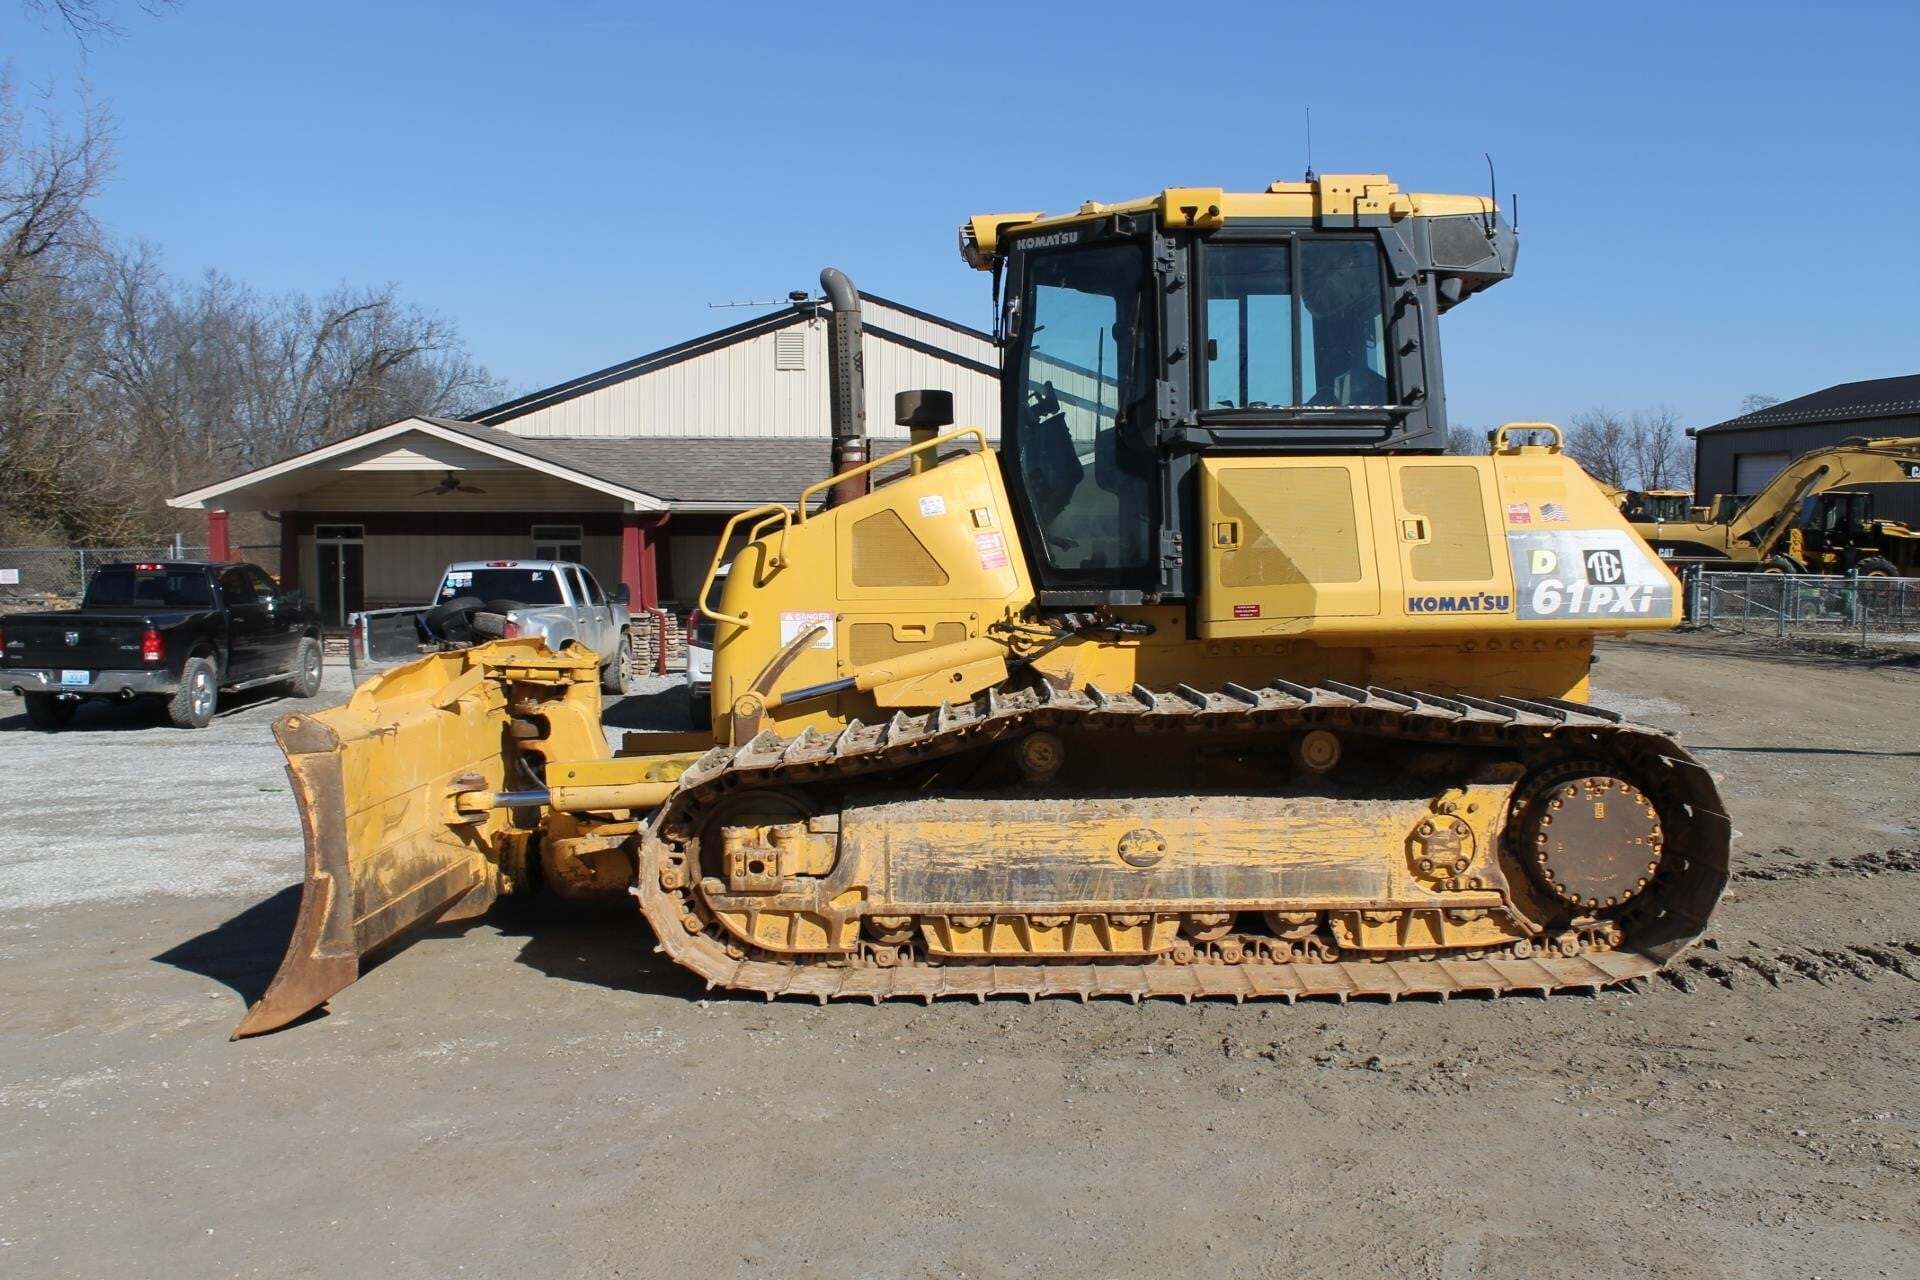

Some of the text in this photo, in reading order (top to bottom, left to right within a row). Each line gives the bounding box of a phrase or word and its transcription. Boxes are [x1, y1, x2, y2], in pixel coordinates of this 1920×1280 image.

[1016, 231, 1078, 250] KOMATSU
[1531, 550, 1557, 575] D
[1658, 547, 1674, 558] CAT
[1408, 591, 1509, 612] KOMATSU
[1532, 578, 1654, 615] 61PXi
